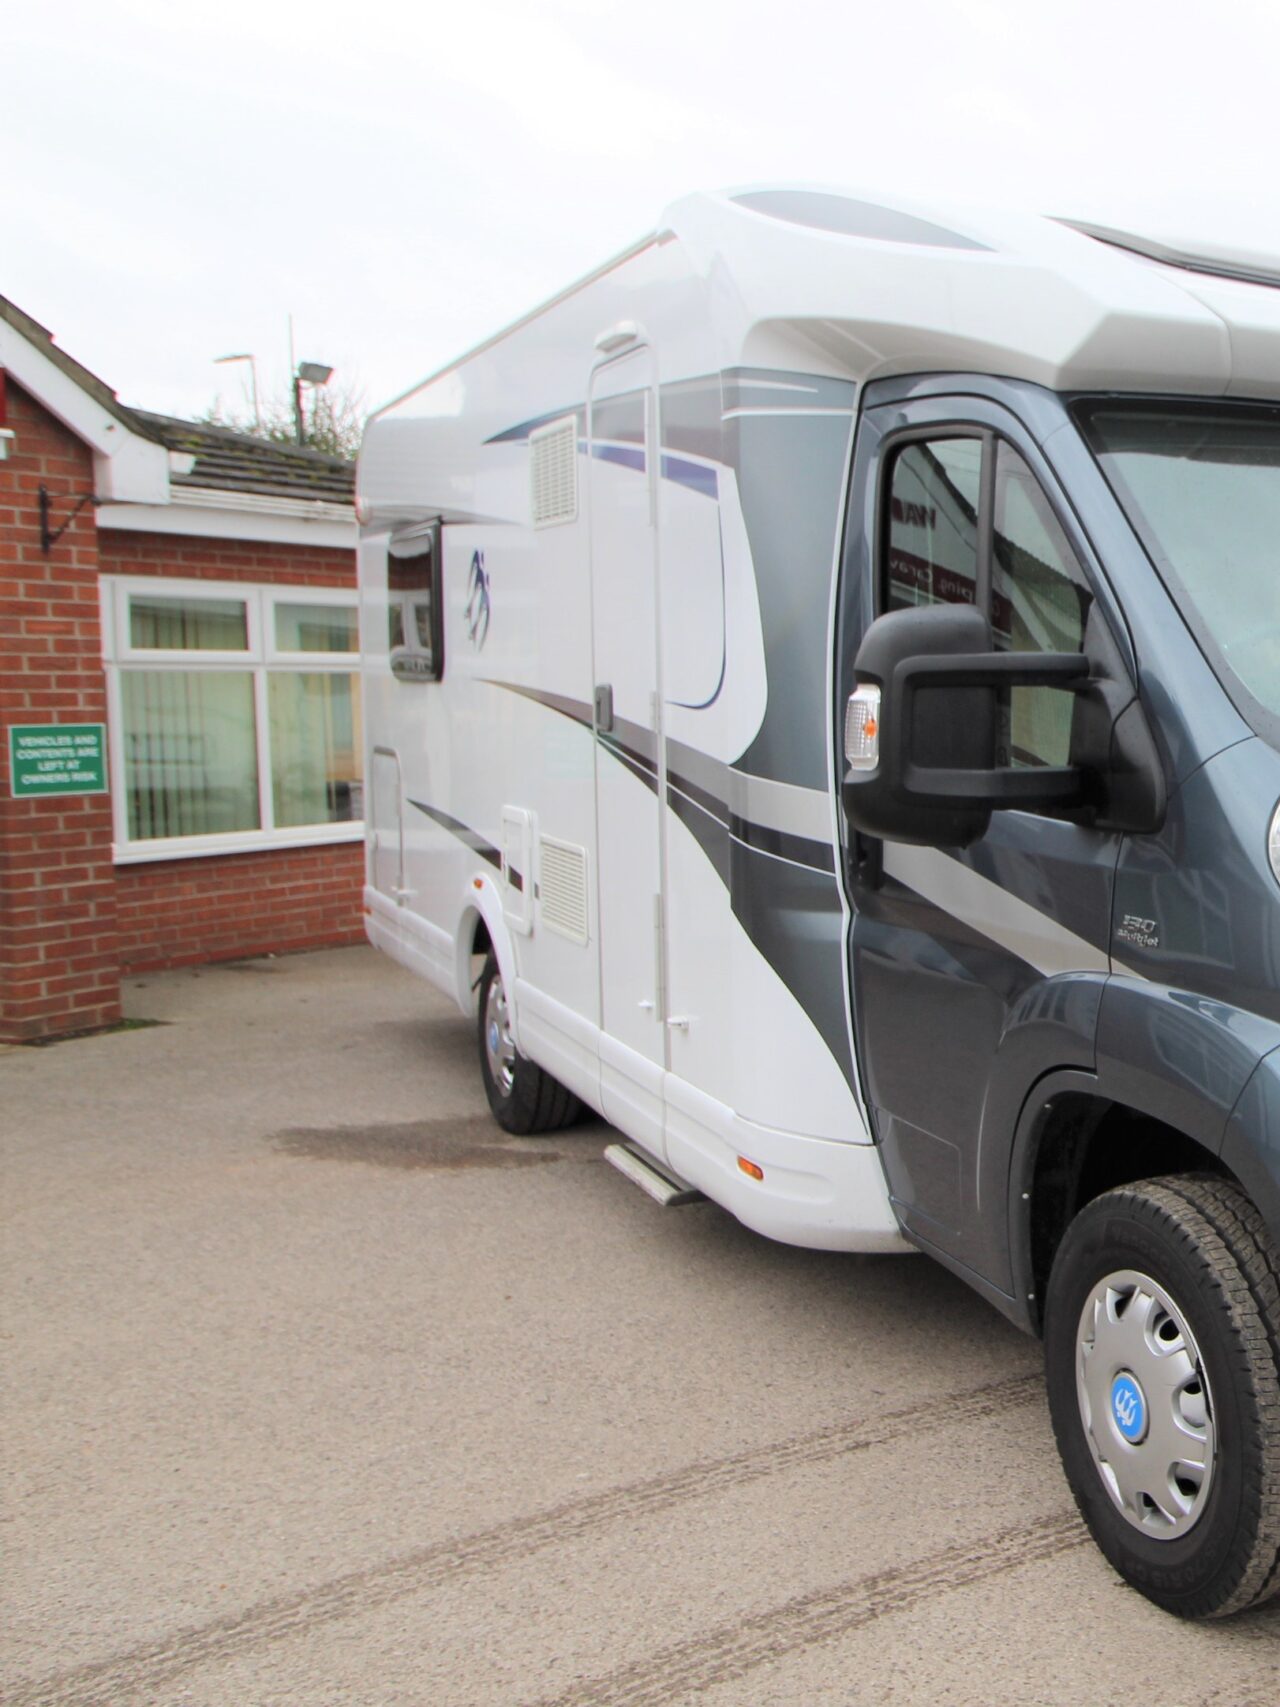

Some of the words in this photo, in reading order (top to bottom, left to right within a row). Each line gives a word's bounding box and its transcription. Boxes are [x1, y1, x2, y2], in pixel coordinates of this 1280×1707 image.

[19, 736, 72, 747] VEHICLES
[74, 734, 98, 745] AND
[17, 748, 75, 759] CONTENTS
[77, 747, 99, 757] ARE
[38, 760, 65, 771] LEFT
[66, 759, 80, 770] AT
[22, 773, 70, 785] OWNERS
[71, 771, 98, 782] RISK
